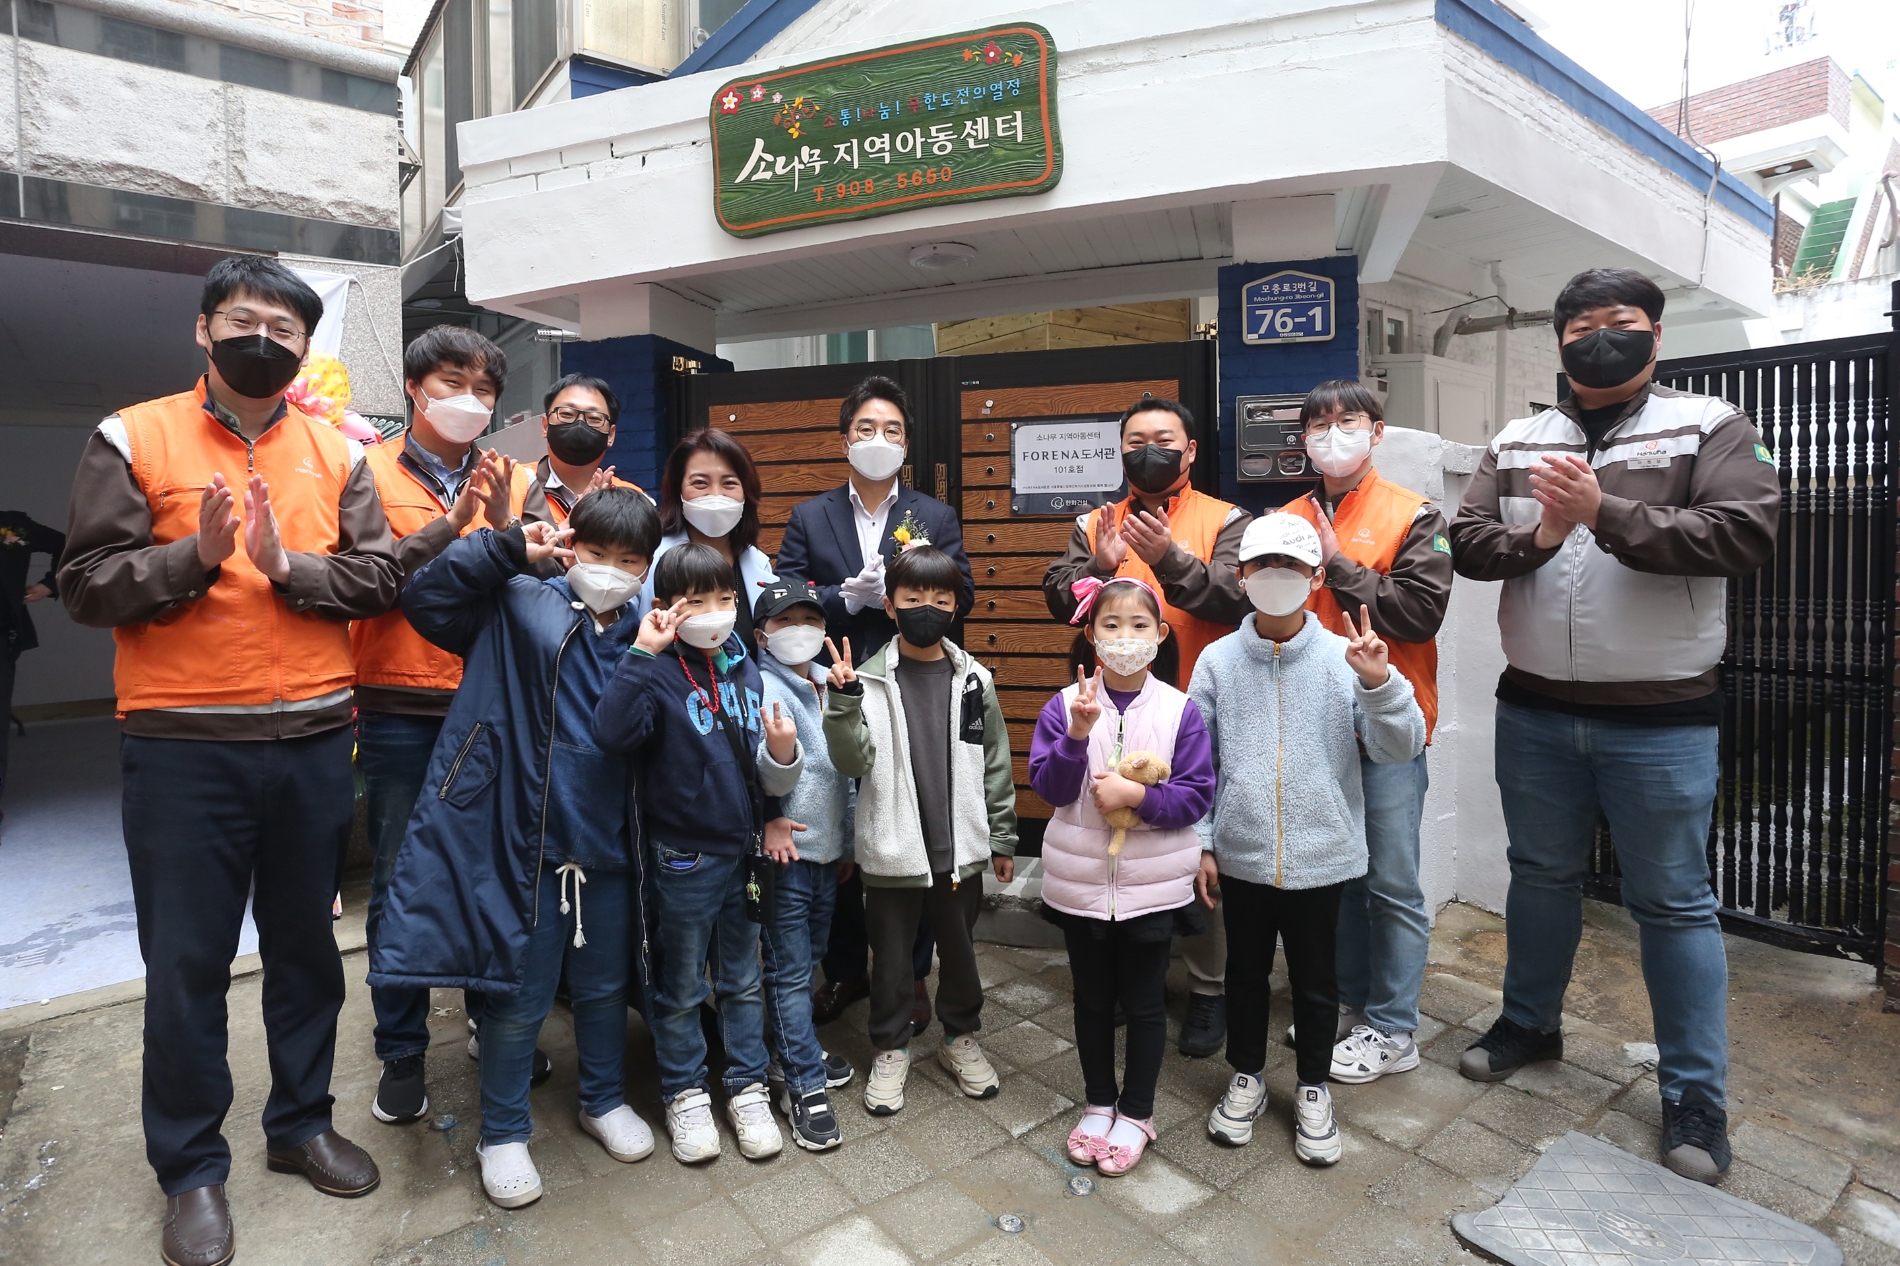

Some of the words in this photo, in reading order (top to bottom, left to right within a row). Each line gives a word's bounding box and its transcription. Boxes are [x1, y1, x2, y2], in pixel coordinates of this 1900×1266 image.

[907, 79, 1021, 113] 무한도전의열정
[733, 137, 829, 193] 소나무
[832, 110, 1024, 170] 지역아동센터
[1255, 306, 1322, 335] 76-1
[1036, 433, 1057, 441] 소나무
[1059, 431, 1101, 440] 지역아동센터
[1022, 447, 1116, 461] FORENA도서관
[1054, 465, 1084, 474] 101호점
